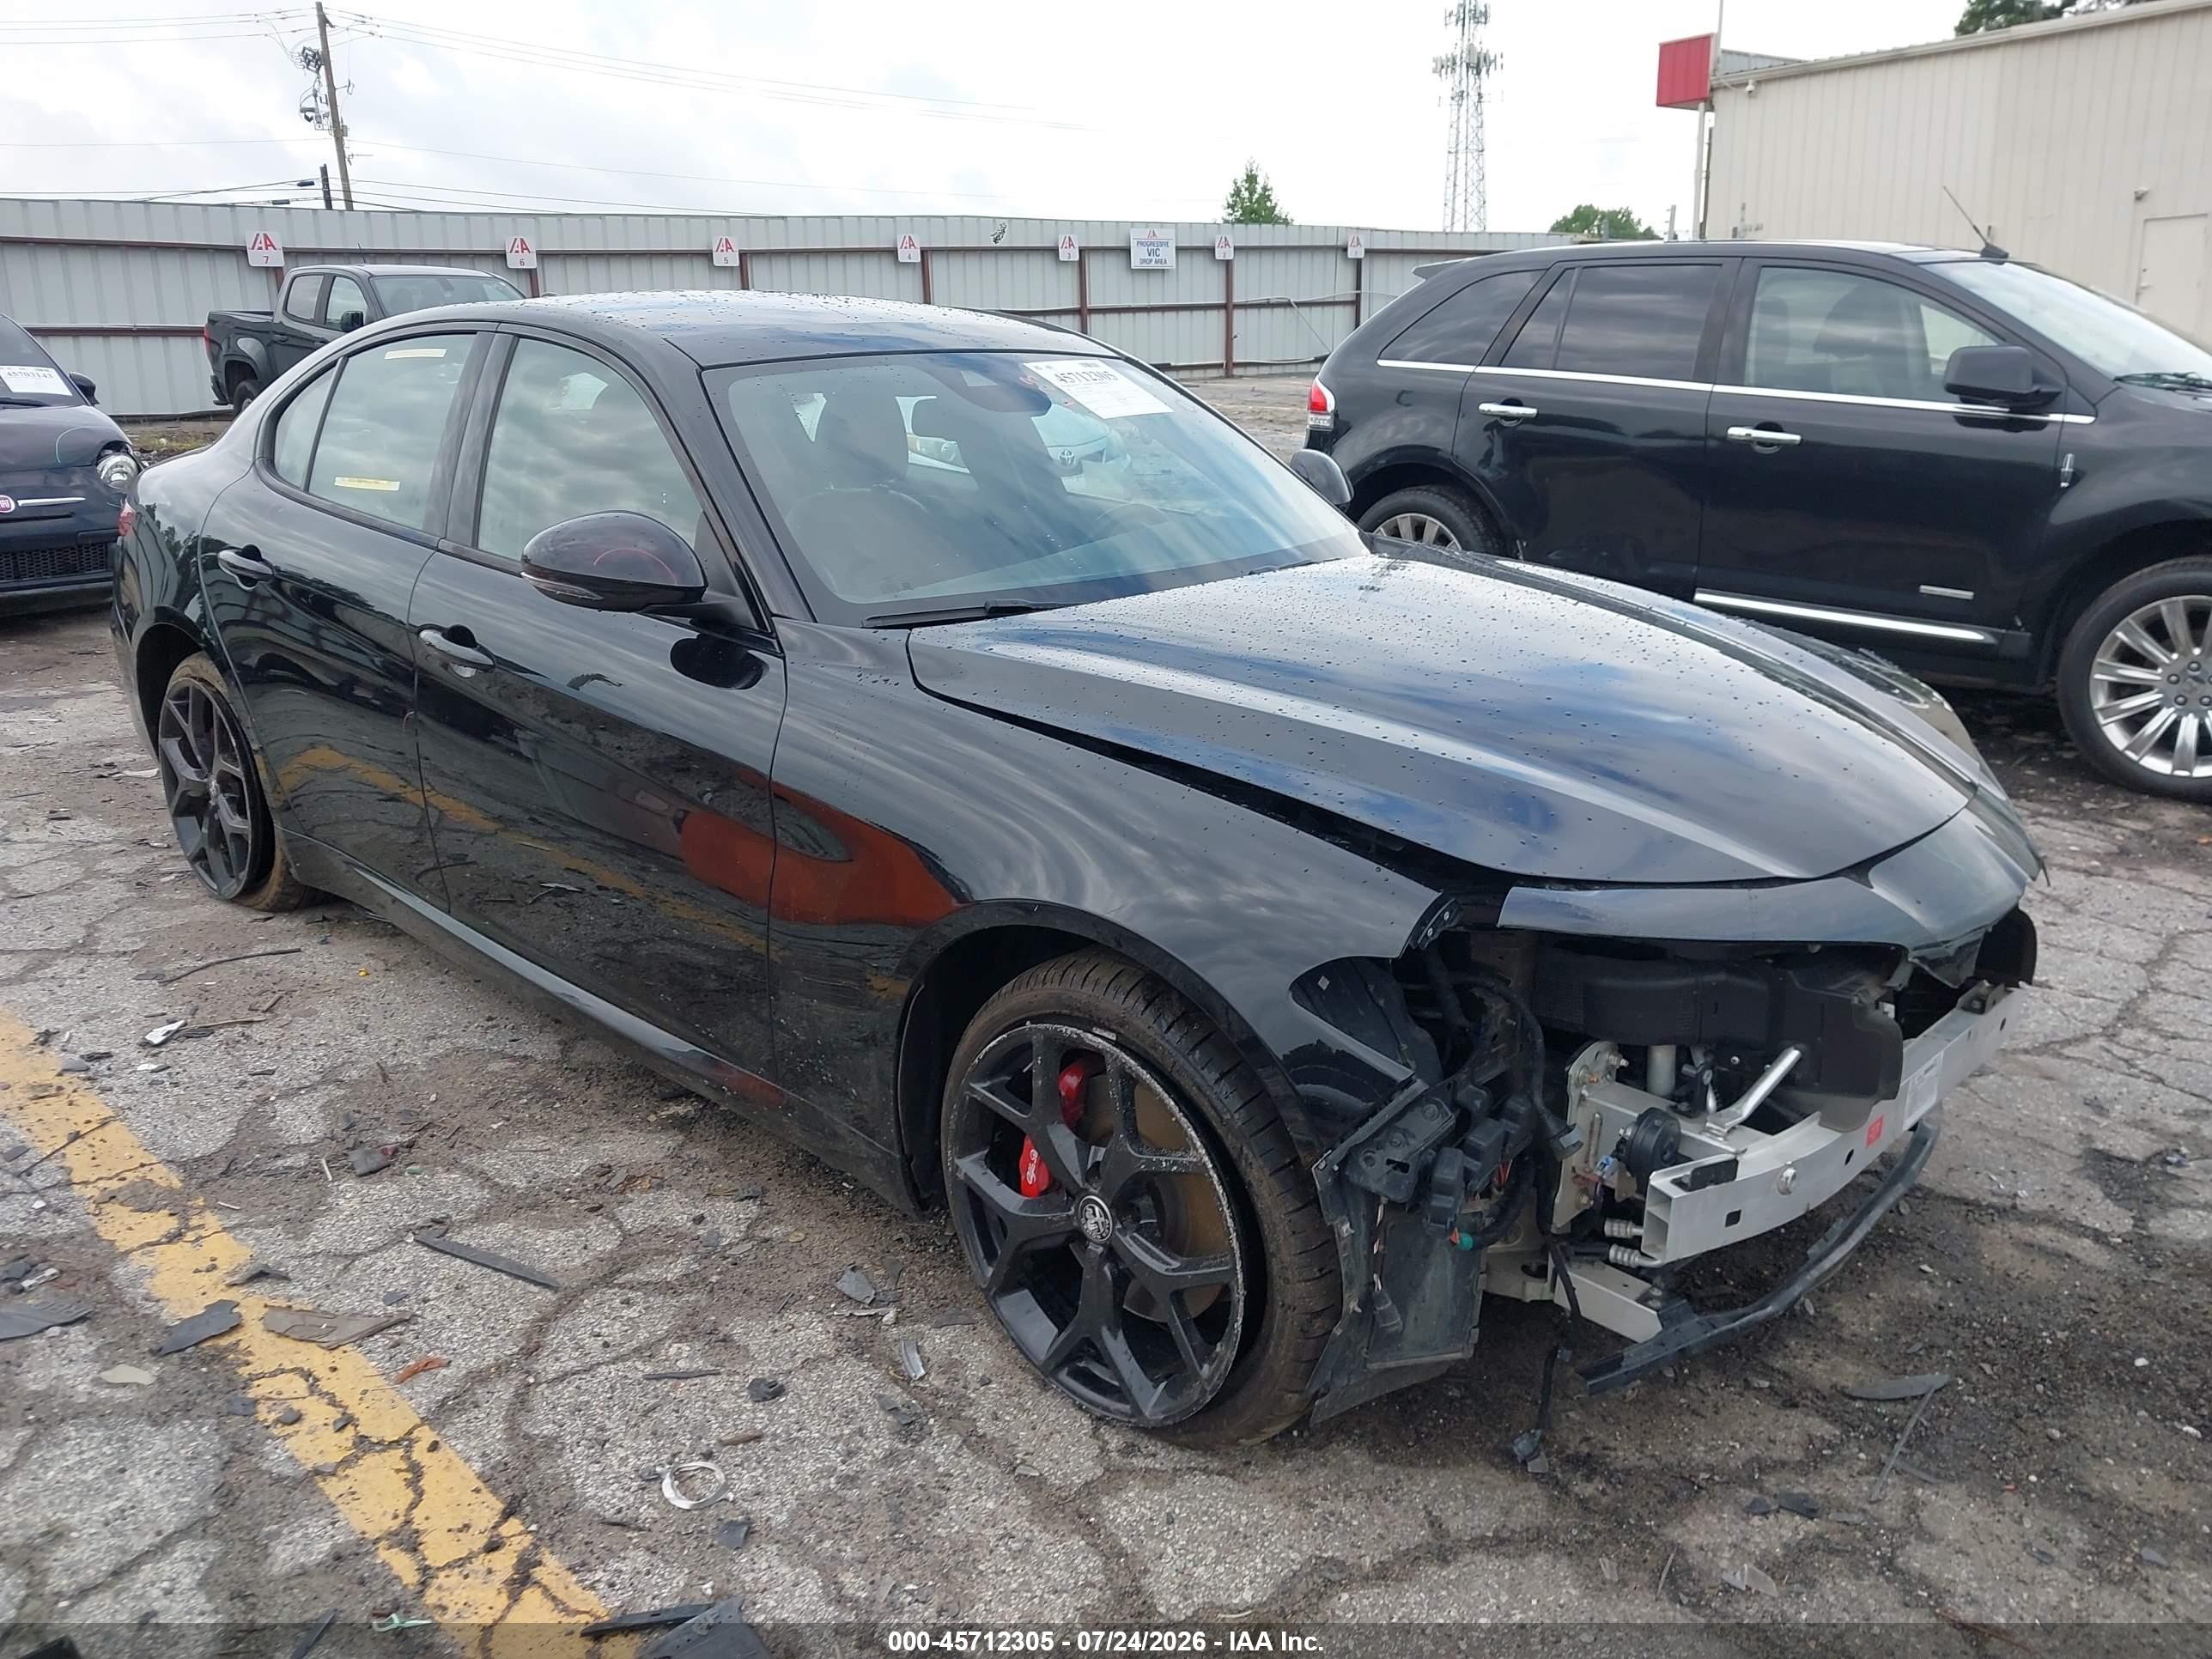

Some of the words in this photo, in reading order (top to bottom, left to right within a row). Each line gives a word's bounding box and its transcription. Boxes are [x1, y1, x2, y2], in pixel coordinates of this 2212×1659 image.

[1146, 247, 1161, 258] VIC
[262, 255, 269, 264] 7
[519, 258, 525, 267] 6
[723, 256, 729, 264] 5
